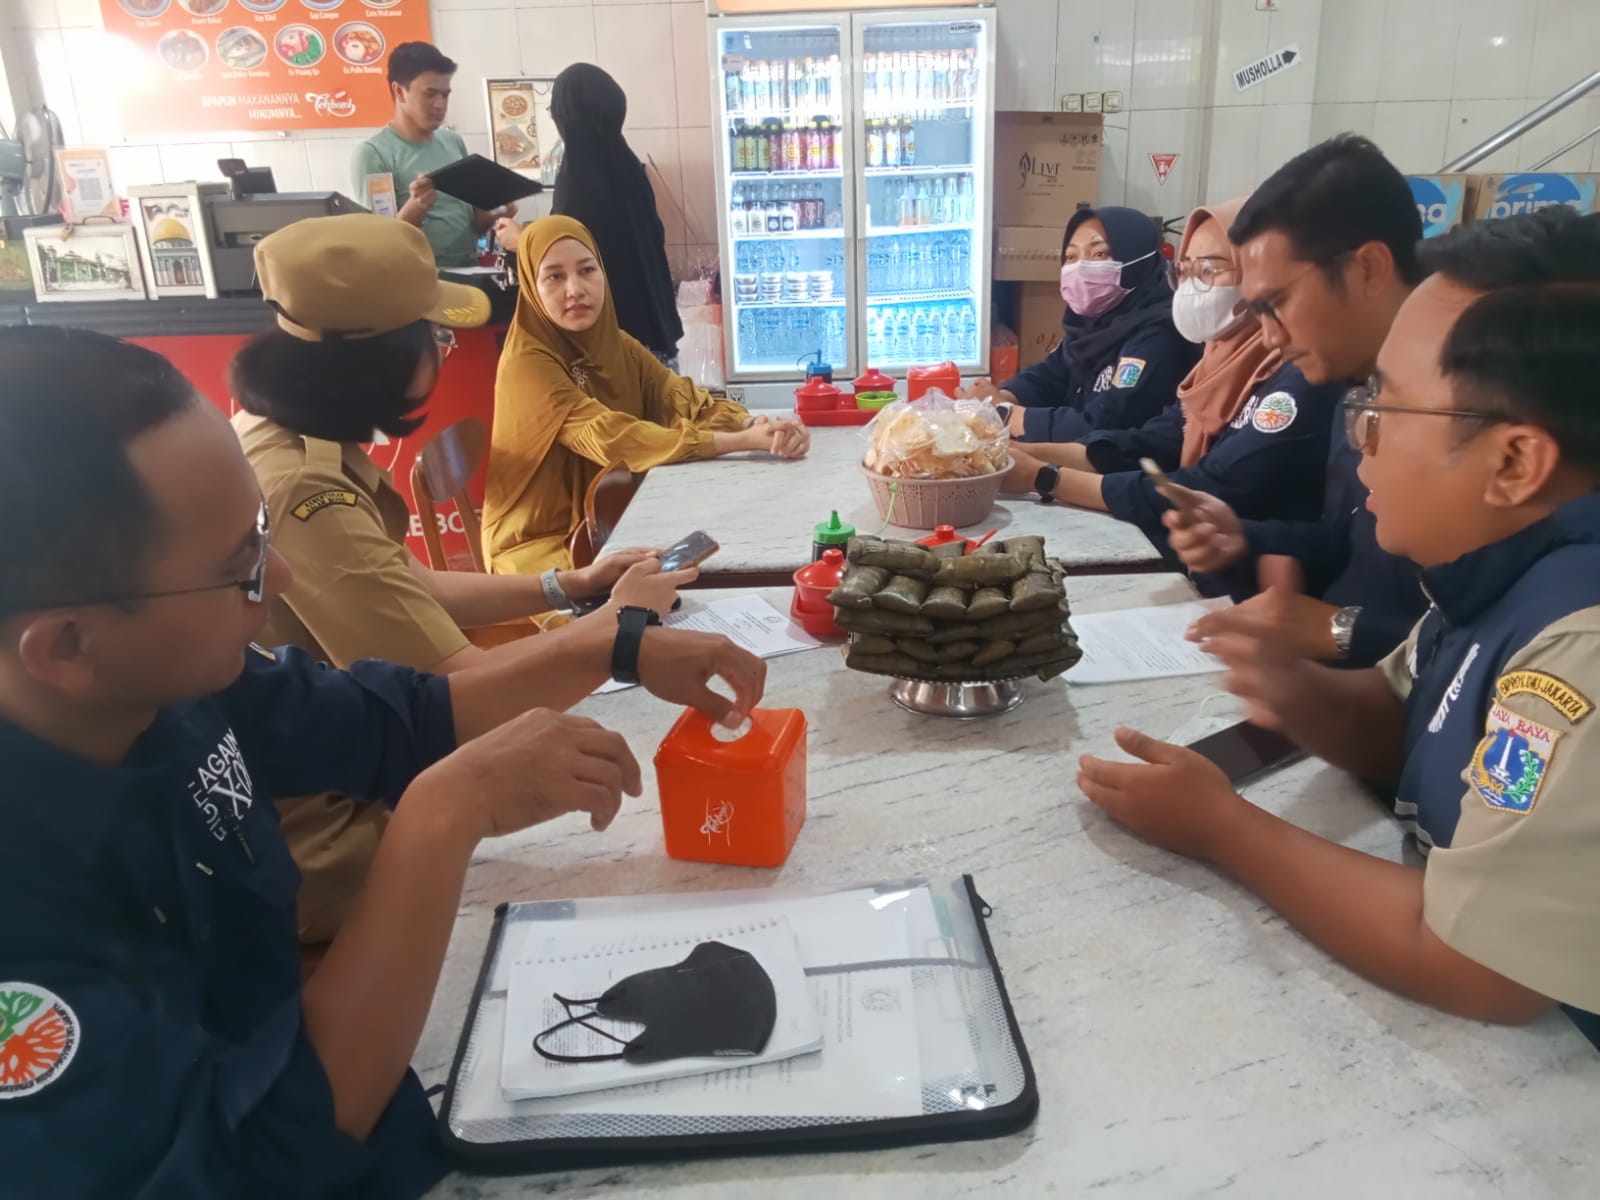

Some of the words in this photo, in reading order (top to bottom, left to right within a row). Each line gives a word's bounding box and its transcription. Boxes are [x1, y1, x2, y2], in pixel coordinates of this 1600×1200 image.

[1236, 54, 1283, 88] MUSHOLLA
[238, 93, 300, 105] MAKANANNYA
[1541, 681, 1584, 719] JAKARTA
[1516, 718, 1551, 743] RAYA
